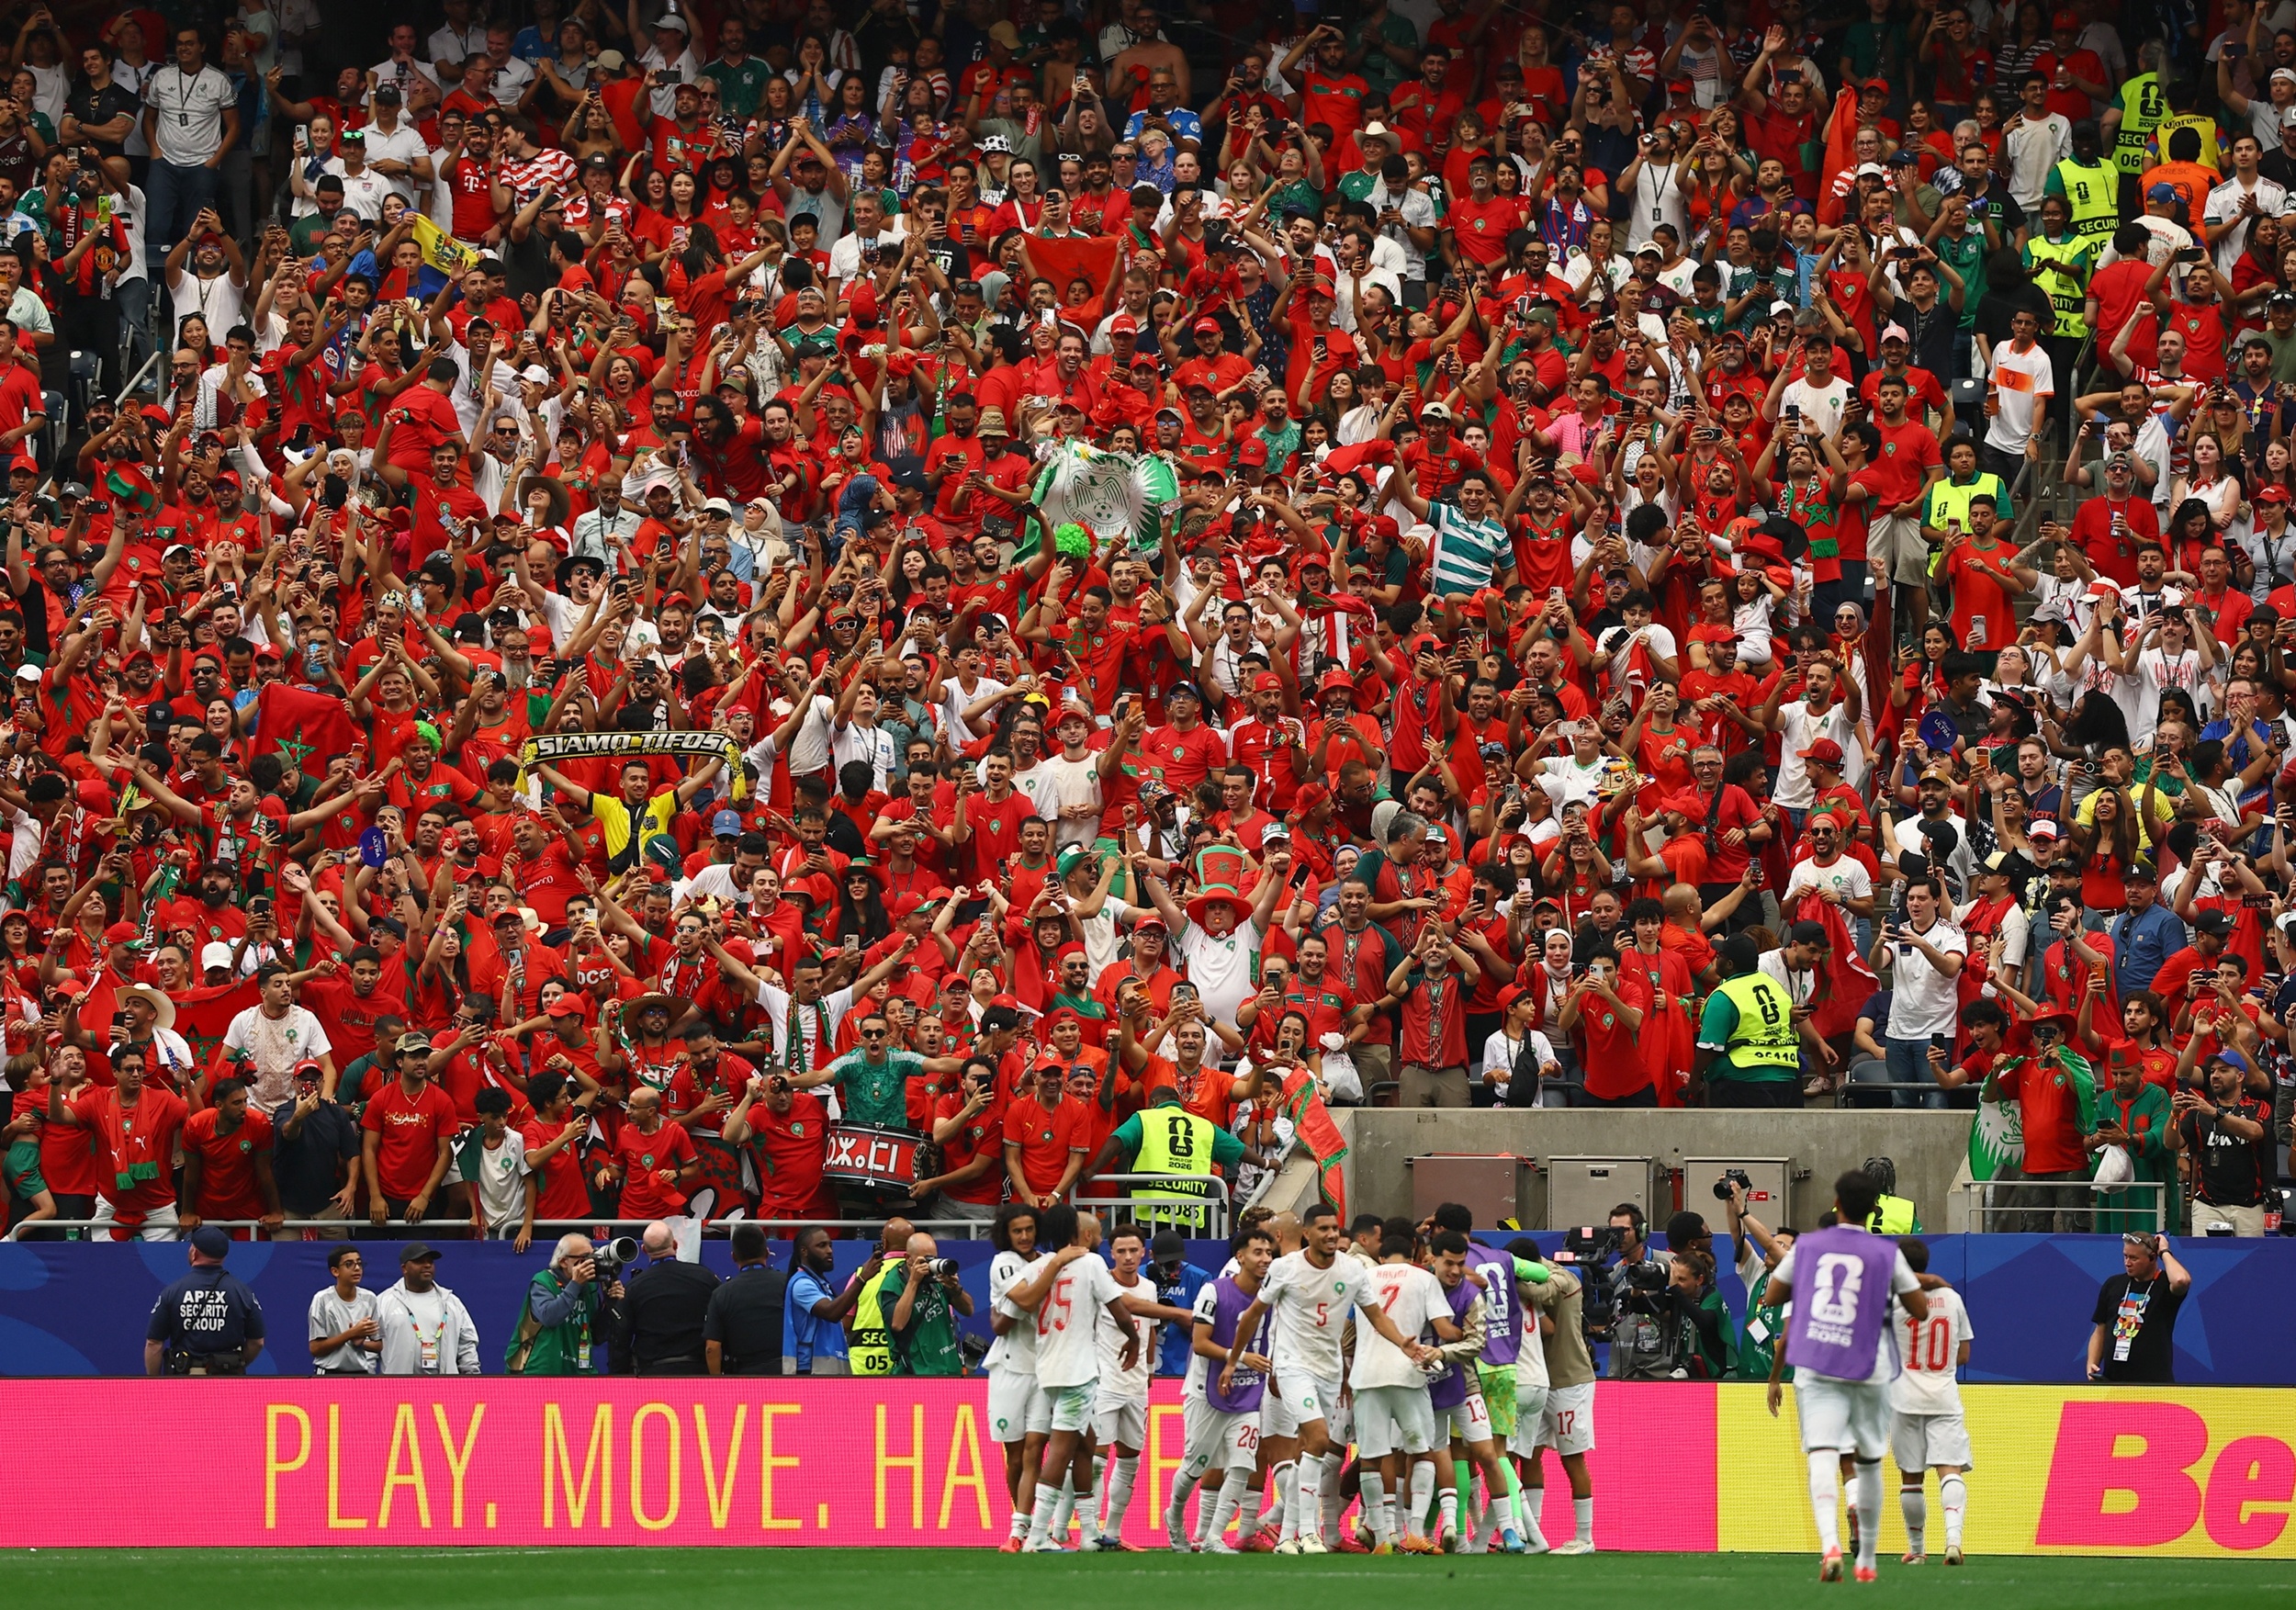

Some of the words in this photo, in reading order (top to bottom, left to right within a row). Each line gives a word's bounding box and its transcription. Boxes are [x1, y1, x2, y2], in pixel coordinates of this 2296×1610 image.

[2163, 117, 2207, 130] Corona
[2119, 132, 2146, 145] SECU
[2121, 153, 2142, 168] 06
[2078, 220, 2118, 235] SECURI
[2089, 240, 2107, 255] 06
[675, 389, 700, 398] ROCCO
[1933, 718, 1951, 738] ULTRA
[537, 734, 631, 756] SIAMO
[641, 732, 727, 752] TIFOSI
[593, 748, 613, 757] Non
[2034, 811, 2057, 820] CITY
[372, 836, 380, 859] ULTRA
[1168, 1161, 1192, 1170] 2026
[183, 1290, 226, 1304] APEX
[1380, 1283, 1401, 1315] 7
[179, 1303, 229, 1318] SECURITY
[1316, 1302, 1328, 1327] 5
[183, 1317, 226, 1332] GROUP
[1490, 1326, 1512, 1339] 202
[1806, 1329, 1852, 1348] 2026
[1905, 1316, 1950, 1371] 10
[865, 1355, 889, 1370] 05
[1466, 1398, 1488, 1424] 13
[1557, 1409, 1576, 1435] 17
[1237, 1424, 1259, 1449] 26
[264, 1403, 497, 1529] PLAY.
[544, 1402, 828, 1530] MOVE.
[2035, 1401, 2296, 1550] Be
